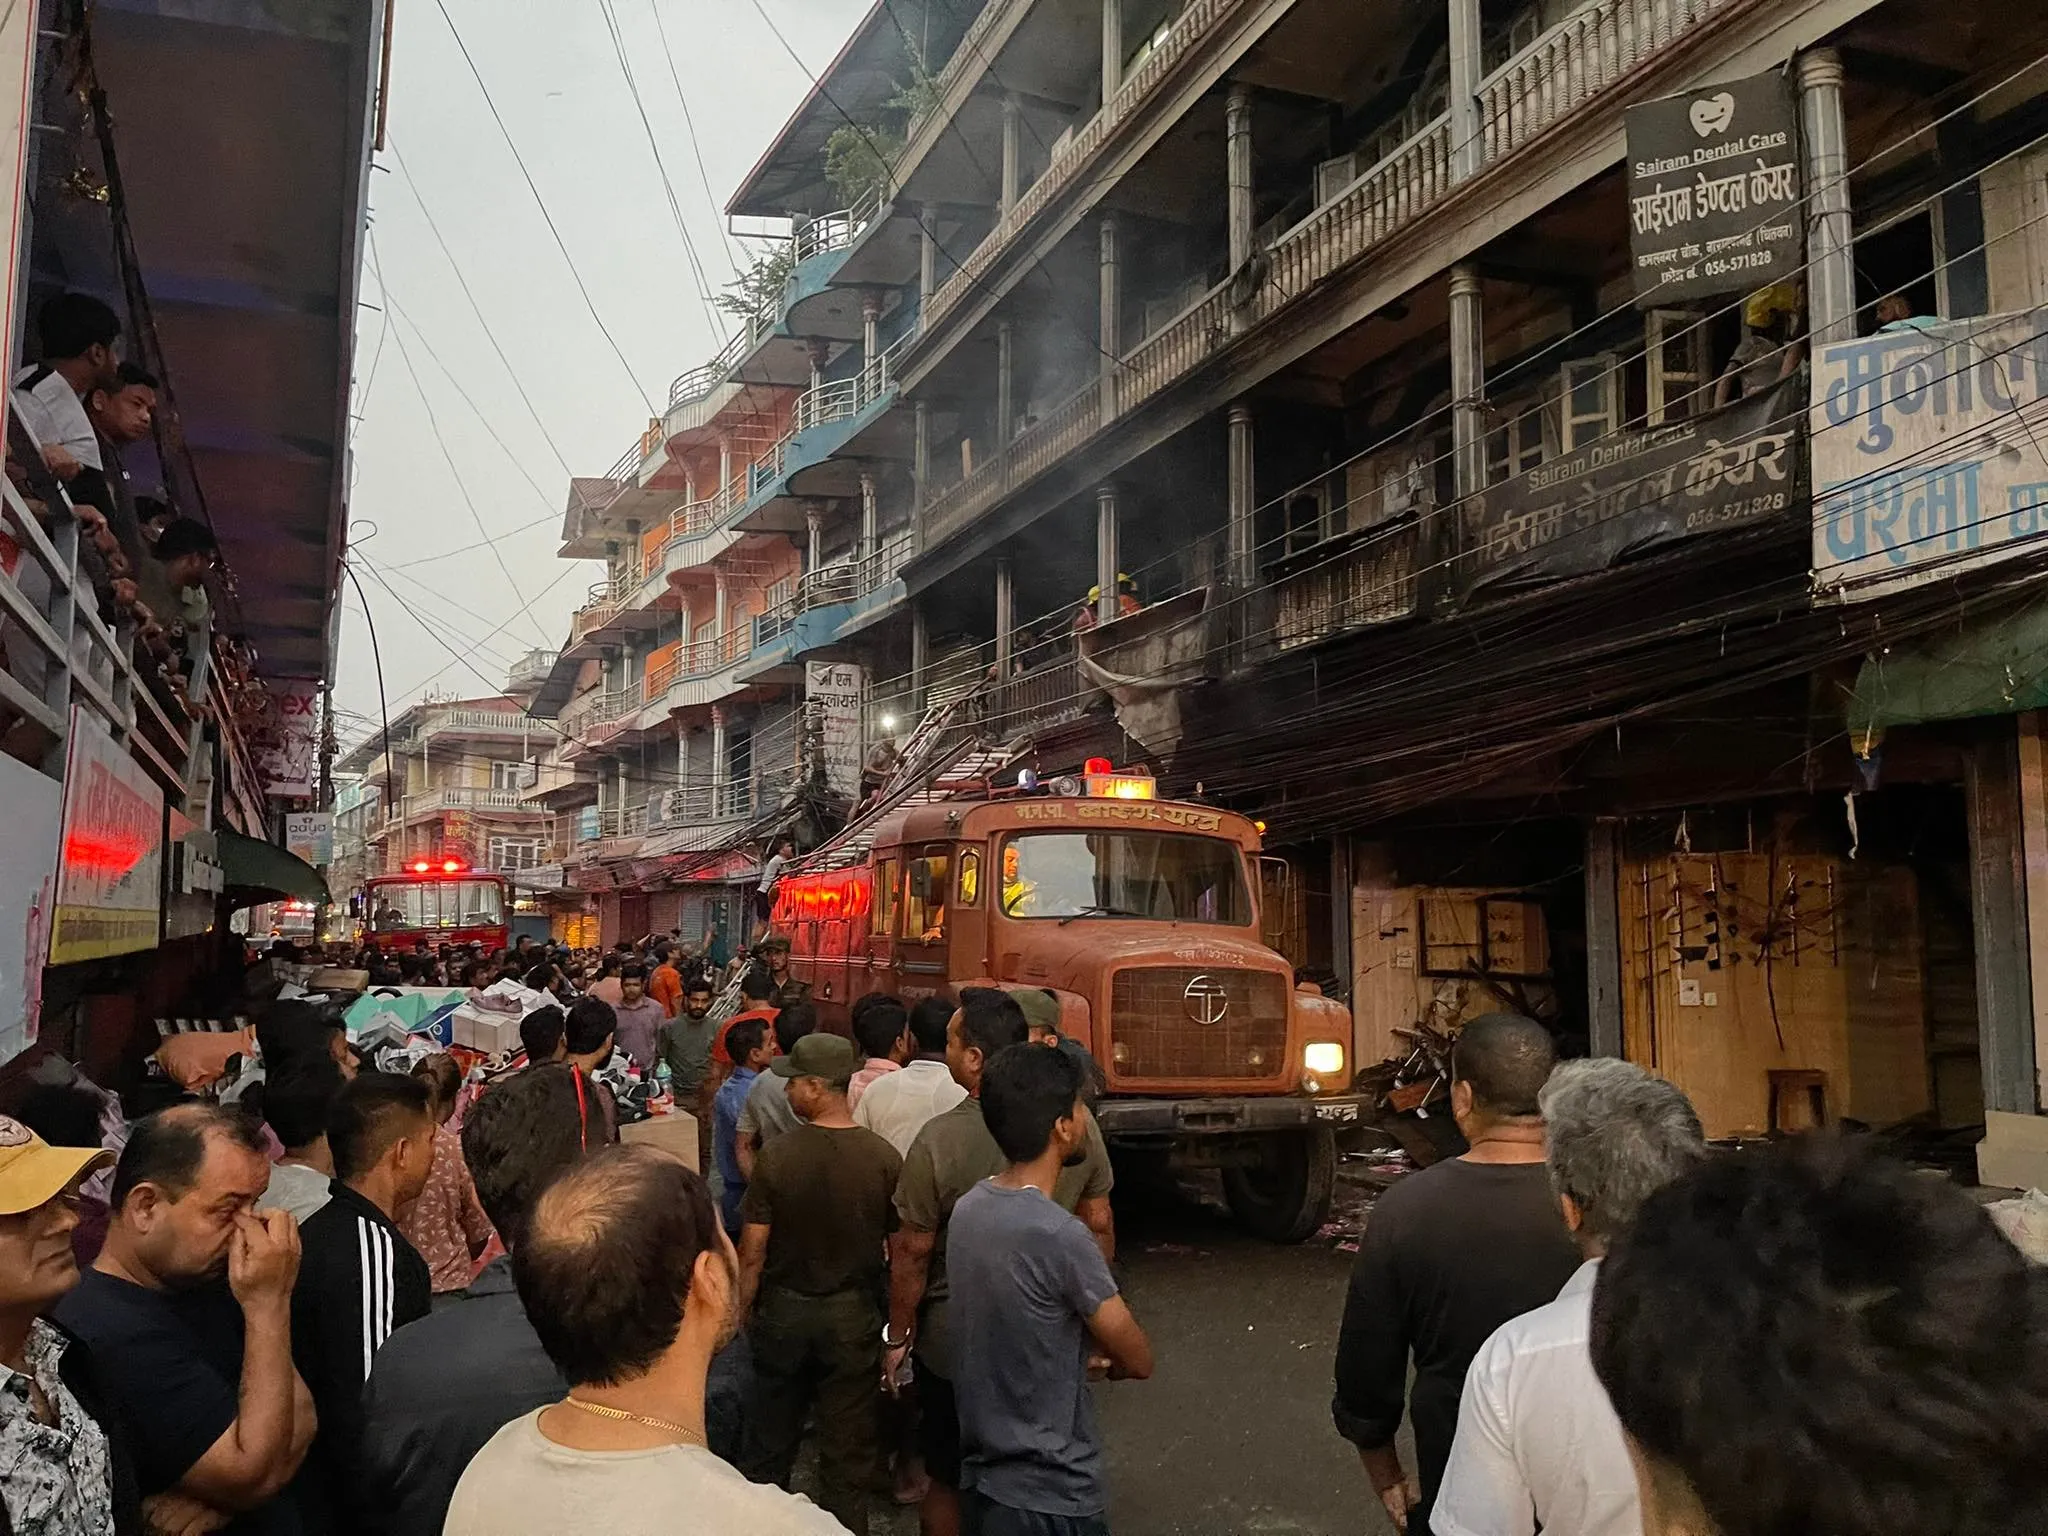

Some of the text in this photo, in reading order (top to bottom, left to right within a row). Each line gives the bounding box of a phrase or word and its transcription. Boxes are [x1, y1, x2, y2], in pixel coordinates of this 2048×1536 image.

[1635, 130, 1787, 176] Sairam Dental Care
[1632, 157, 1796, 235] साईराम डेण्टल केयर
[1704, 250, 1773, 277] 056-571828
[1528, 456, 1587, 489] Sairam
[1590, 430, 1648, 466] Dental
[1684, 429, 1796, 497] केयर
